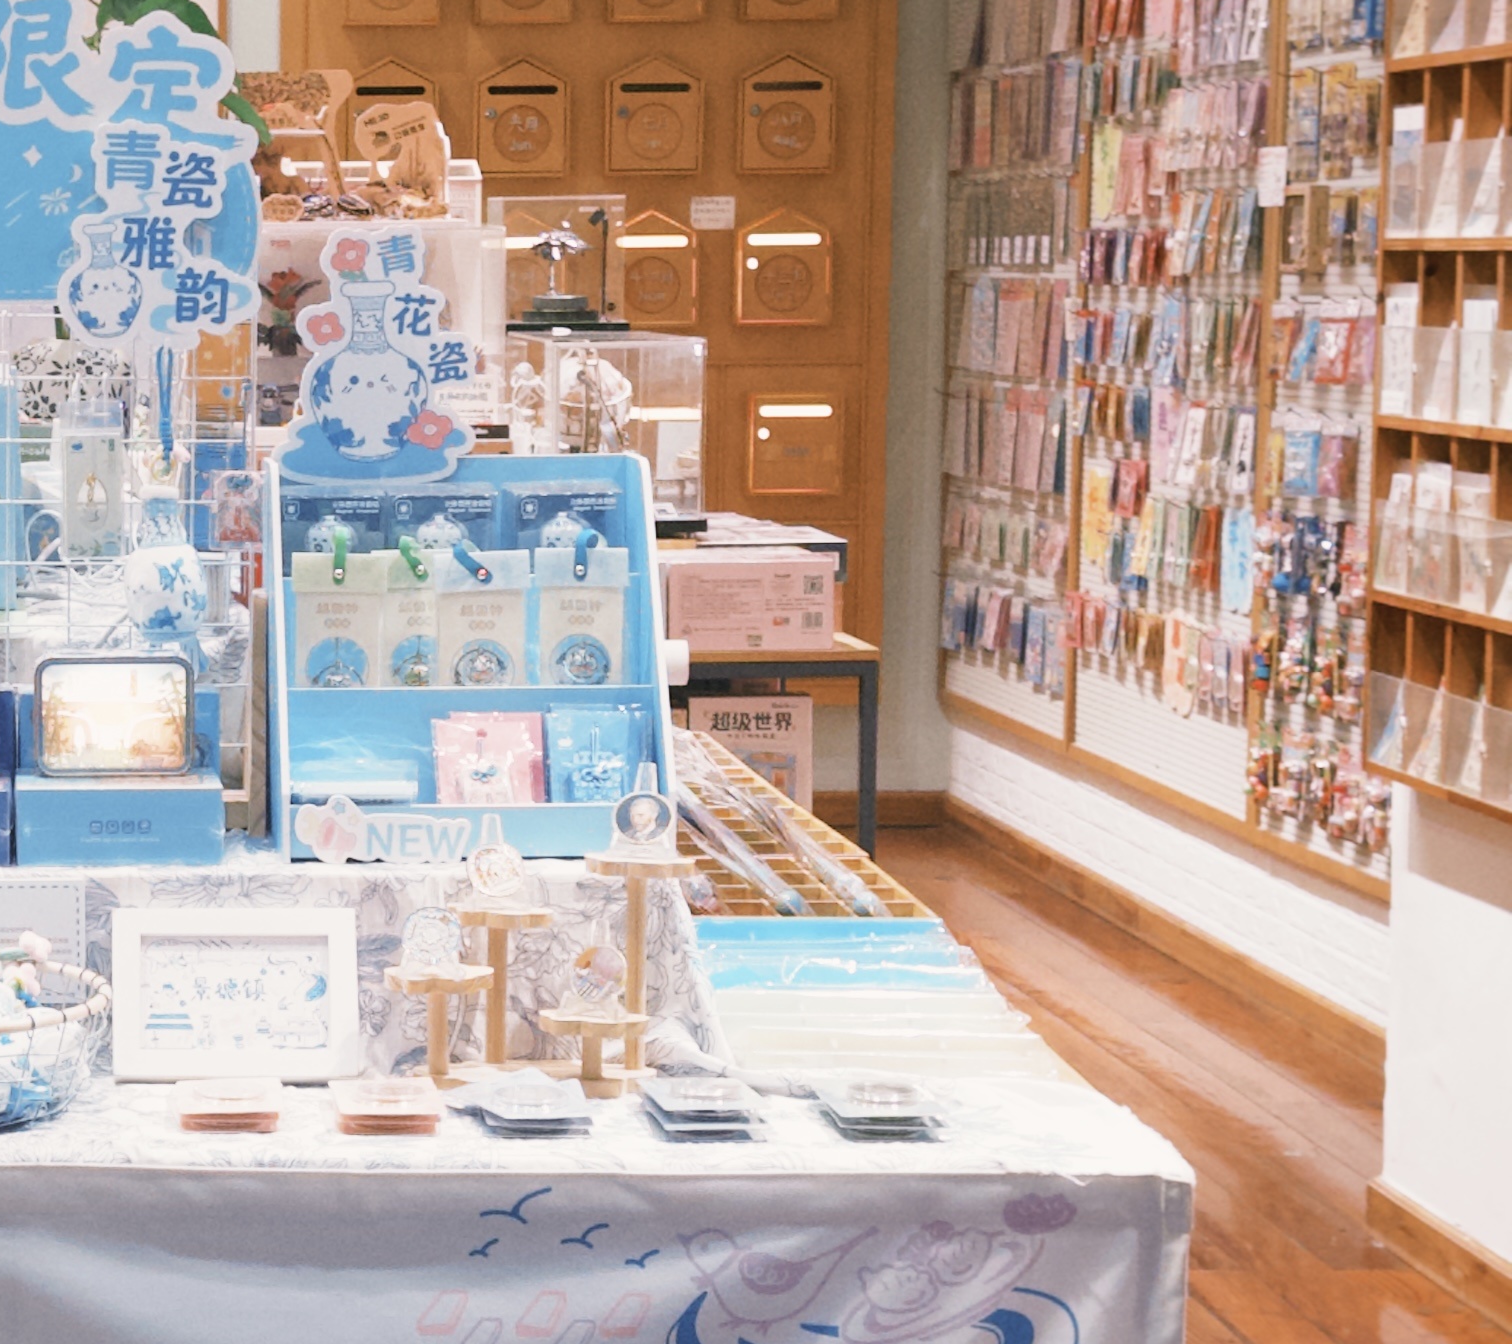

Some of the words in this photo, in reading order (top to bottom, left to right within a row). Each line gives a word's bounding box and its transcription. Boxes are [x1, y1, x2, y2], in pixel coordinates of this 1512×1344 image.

[100, 130, 225, 324] 青瓷雅韵
[377, 235, 469, 384] 青花瓷
[367, 823, 465, 856] NEW
